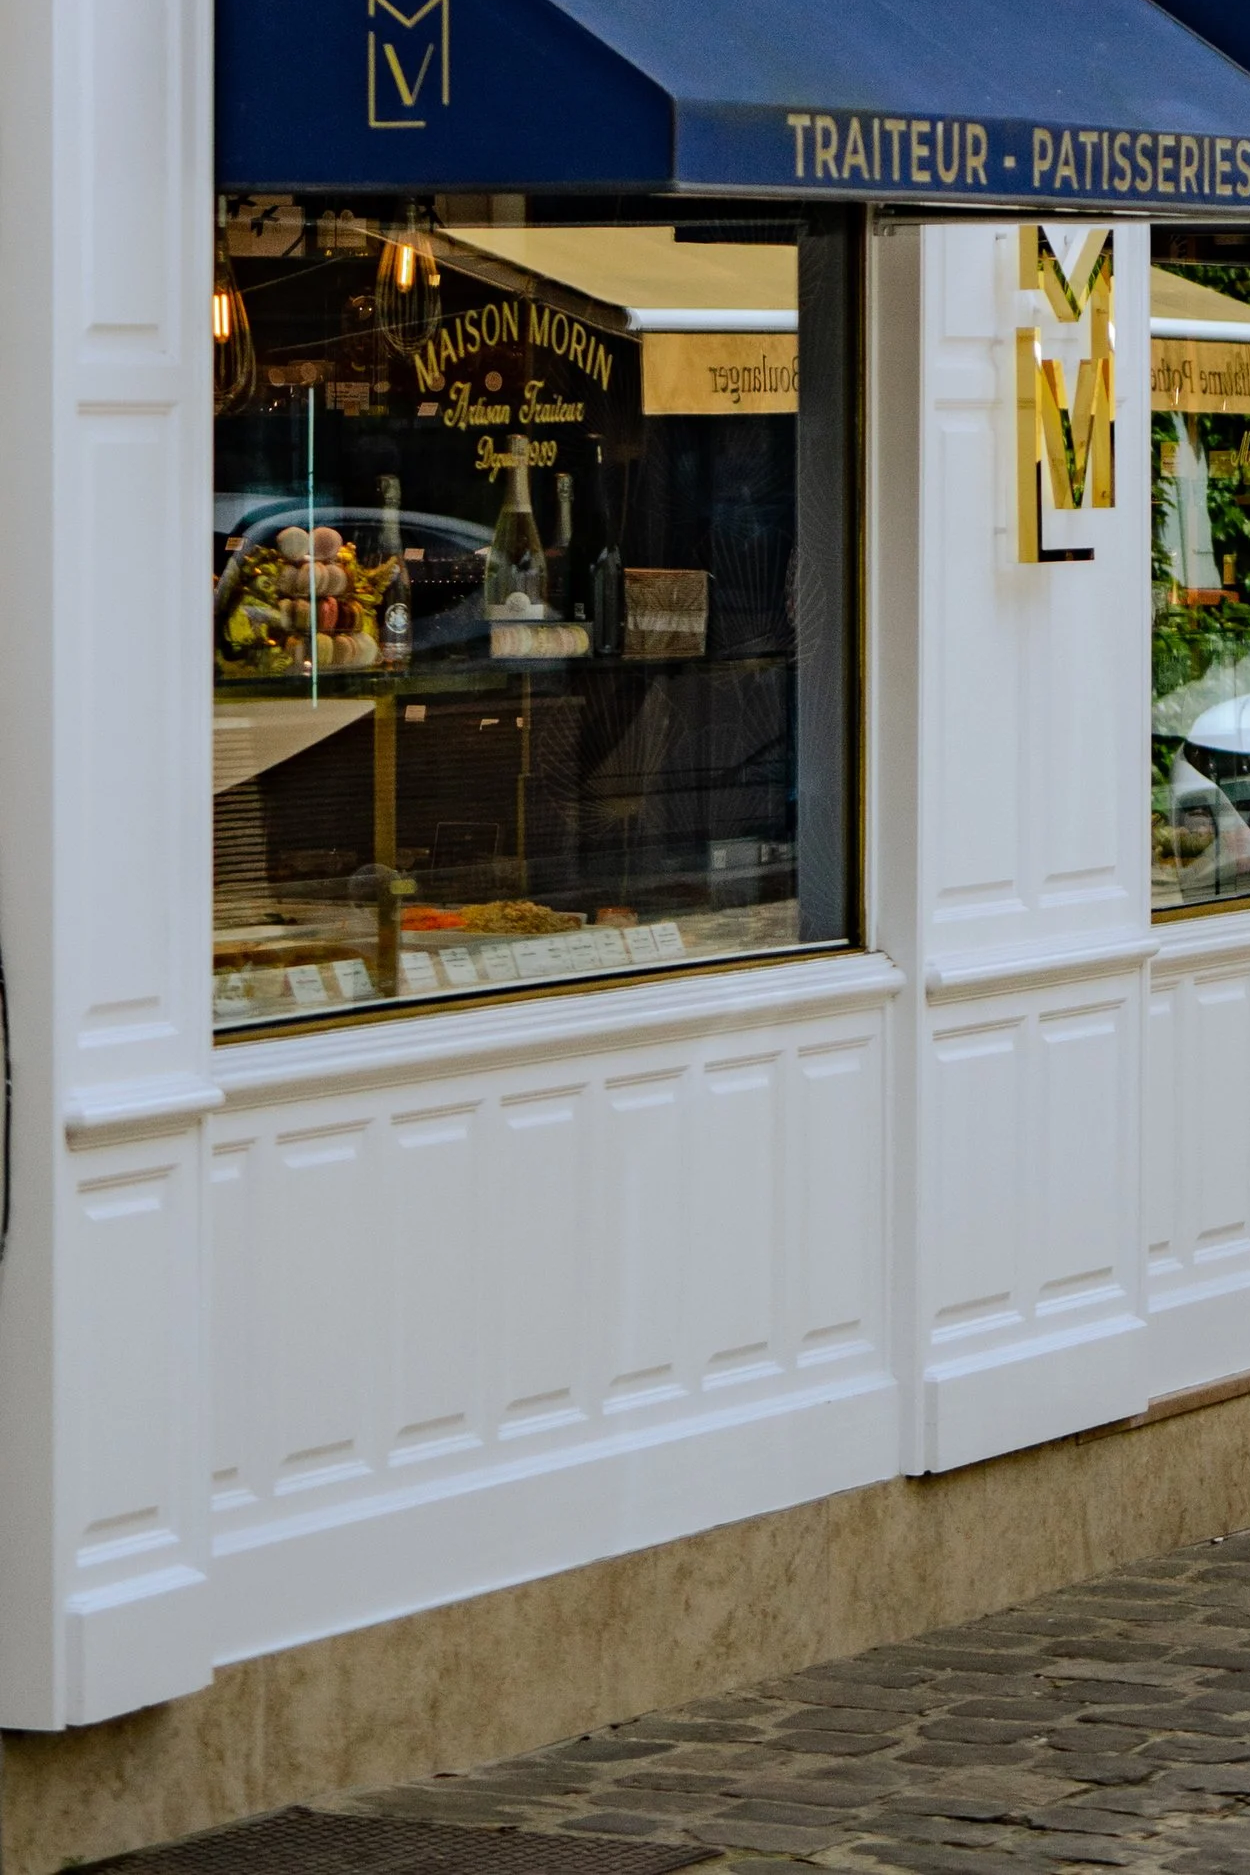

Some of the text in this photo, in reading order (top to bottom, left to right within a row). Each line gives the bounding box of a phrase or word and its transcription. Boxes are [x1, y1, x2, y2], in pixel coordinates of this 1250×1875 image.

[786, 113, 988, 185] TRAITEUR
[414, 301, 613, 393] MAISON MORIN
[444, 380, 585, 431] Artisan Traiteur
